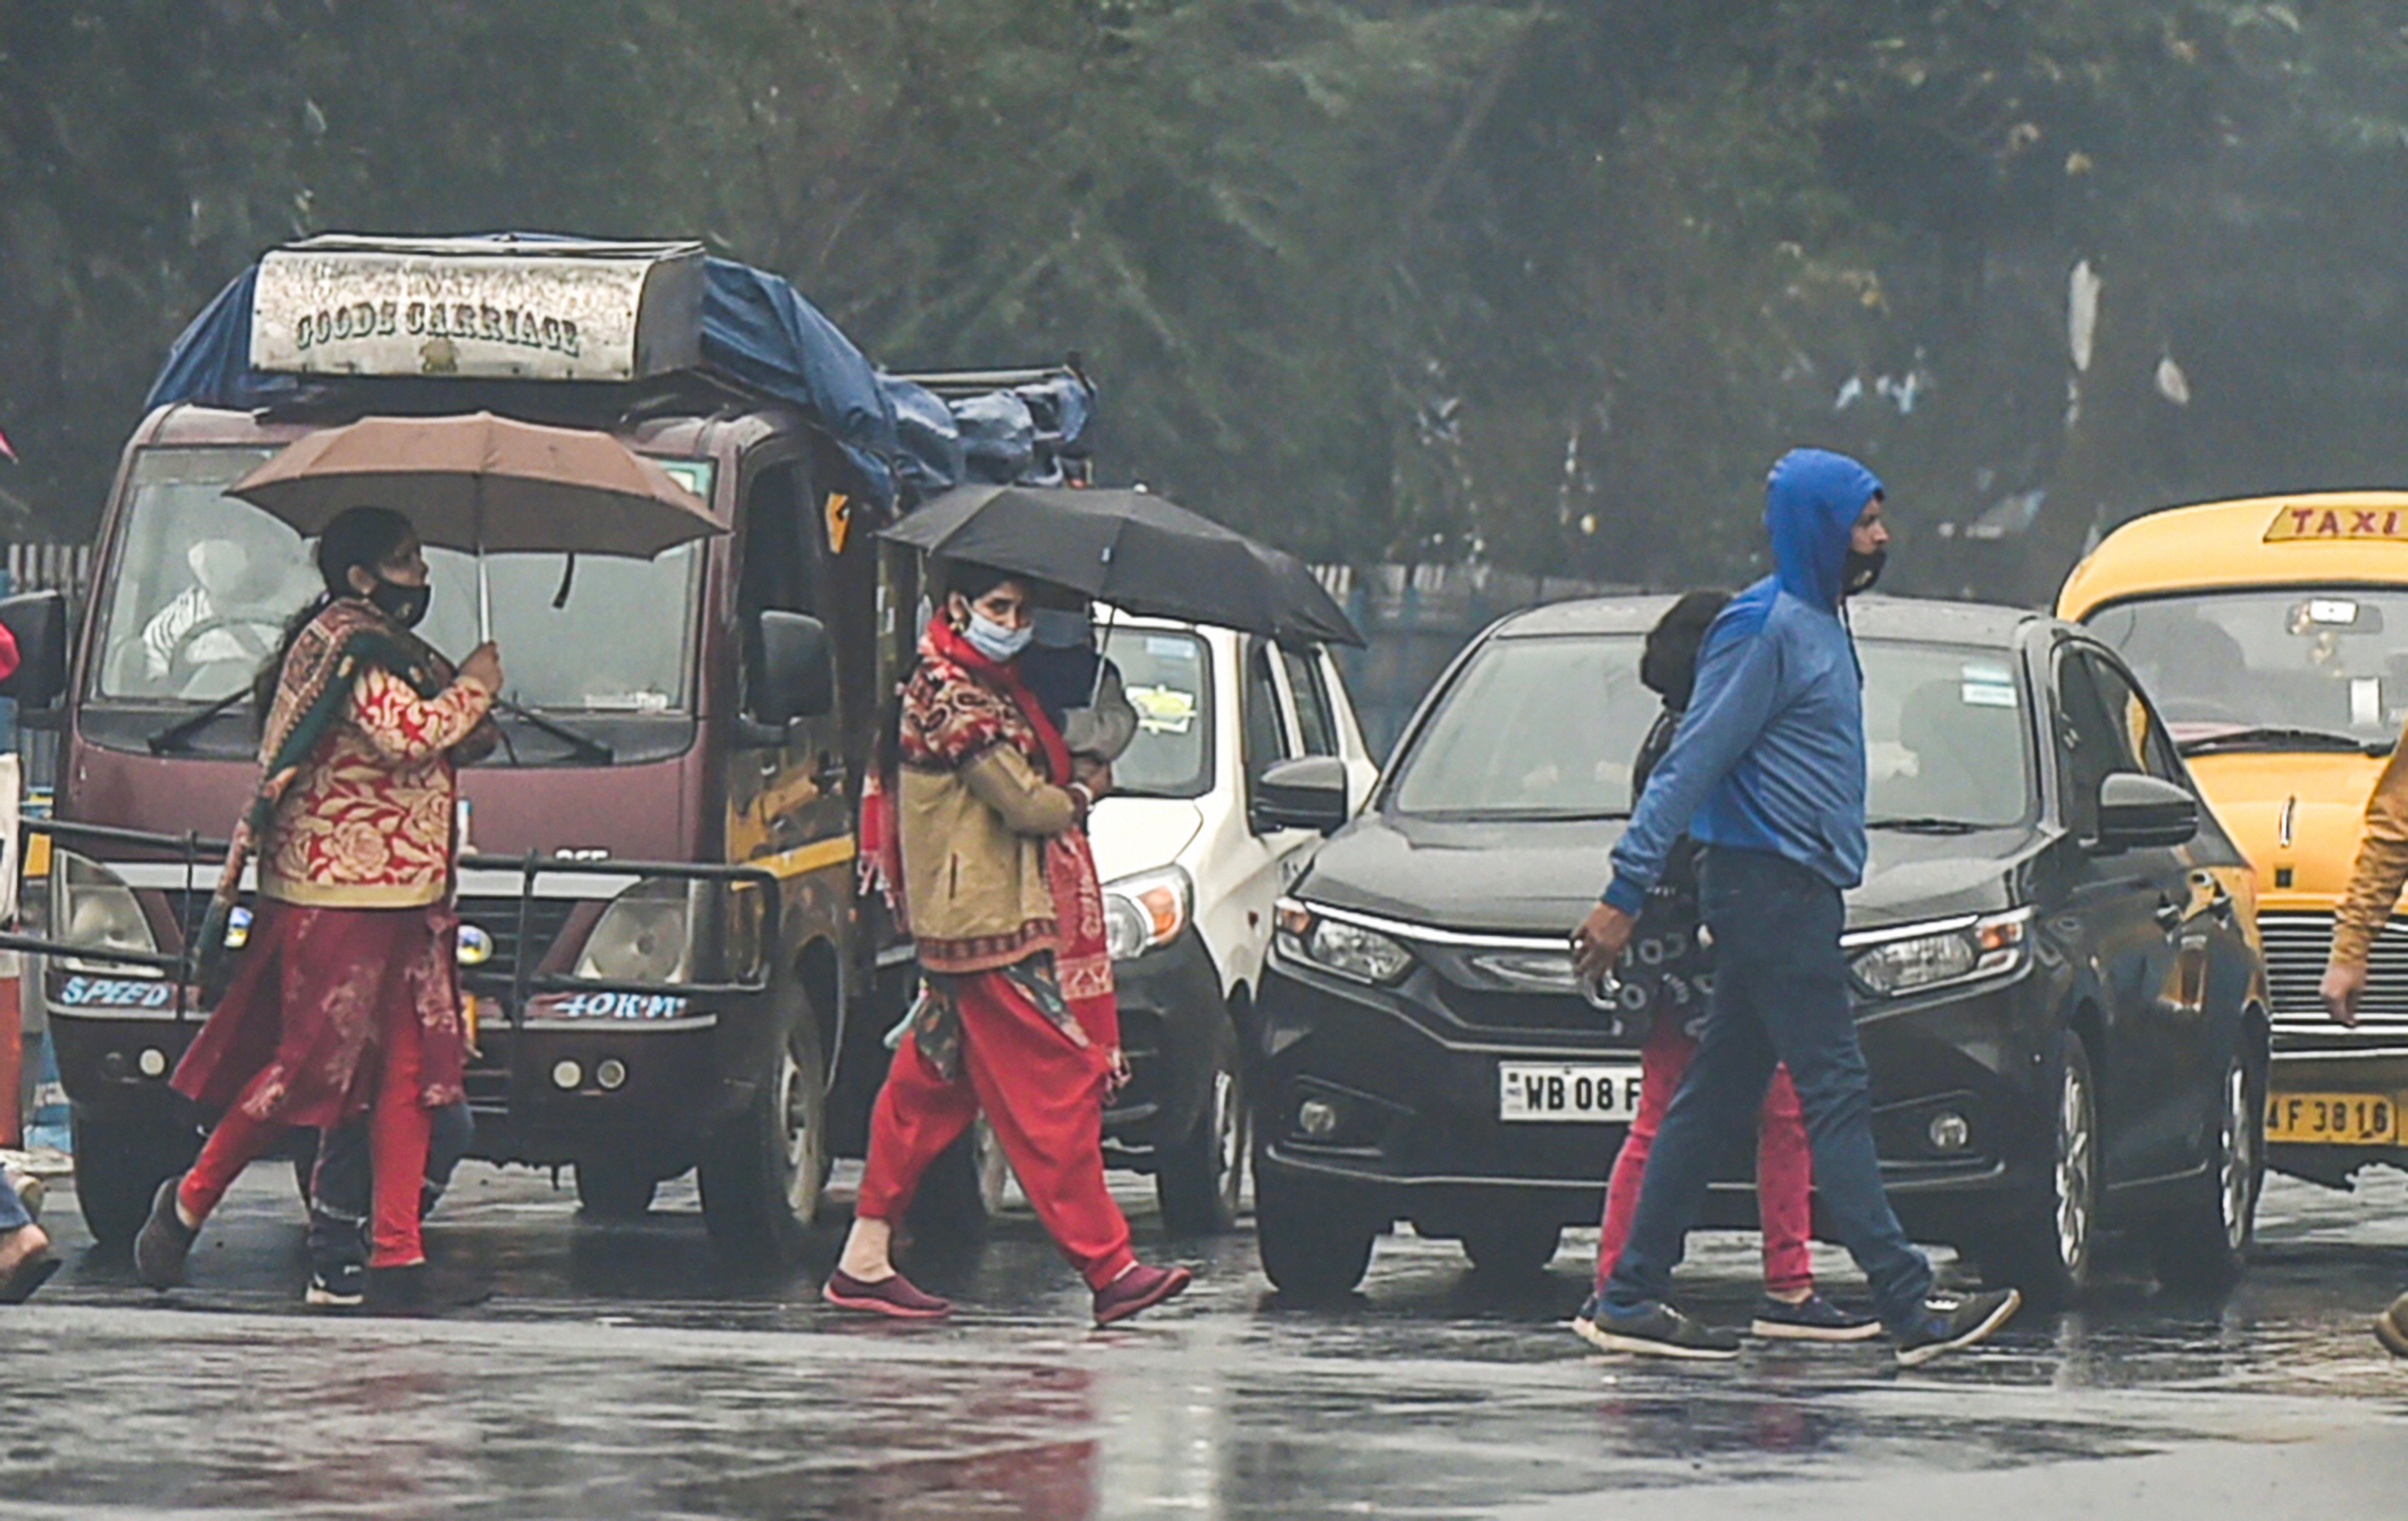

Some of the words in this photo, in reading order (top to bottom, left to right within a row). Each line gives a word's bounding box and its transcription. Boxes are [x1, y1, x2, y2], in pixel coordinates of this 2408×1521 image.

[296, 300, 397, 350] GOODS
[407, 302, 579, 358] CARRIAGE
[2291, 509, 2397, 535] TAXI
[61, 976, 169, 1006] SPEED
[1526, 1076, 1565, 1110] WB
[1575, 1077, 1614, 1110] 08
